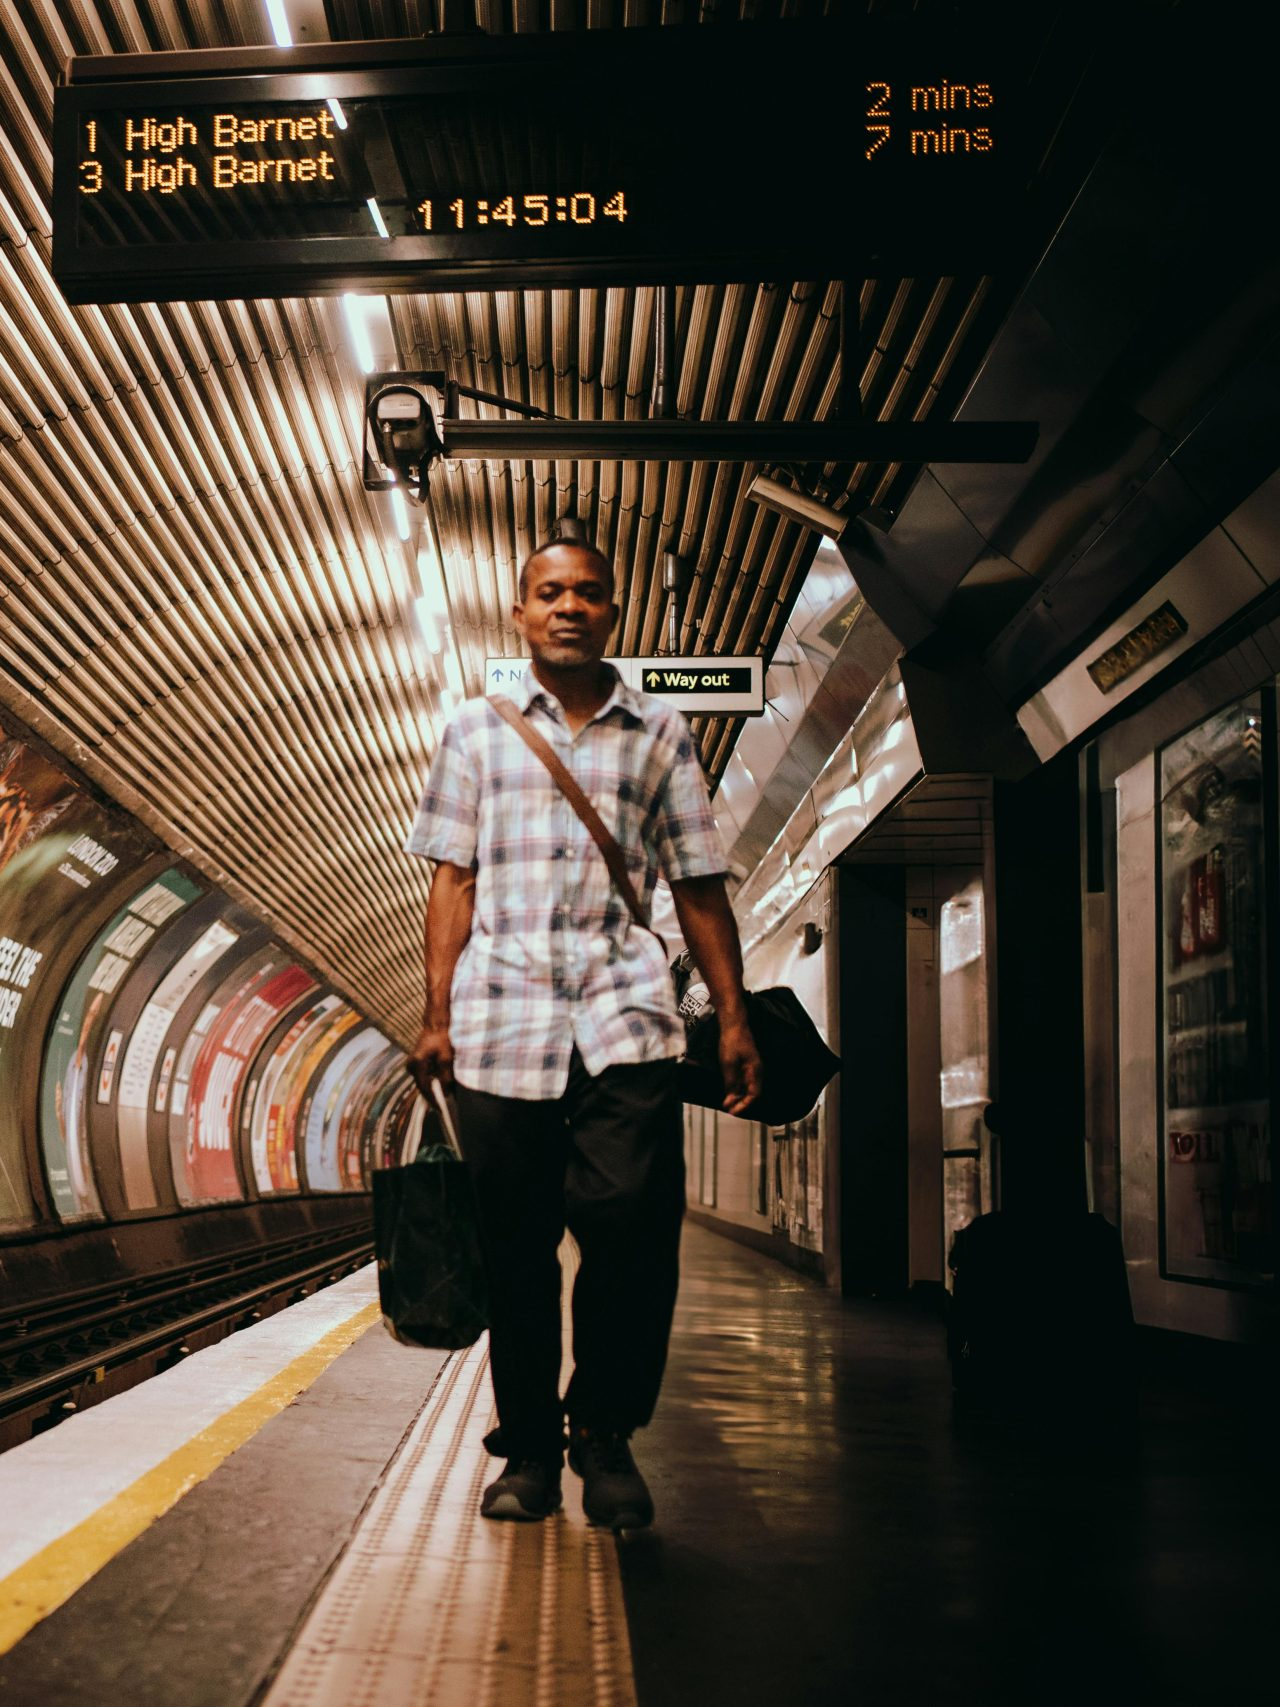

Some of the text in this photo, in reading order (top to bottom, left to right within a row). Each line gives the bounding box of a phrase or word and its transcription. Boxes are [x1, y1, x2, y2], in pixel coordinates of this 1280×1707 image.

[86, 79, 994, 153] 1 High Barnet 2 mins
[79, 123, 994, 194] 3 High Barnet 7 mins
[418, 192, 628, 230] 11:45:04
[663, 672, 730, 690] Way out
[9, 946, 43, 989] THE
